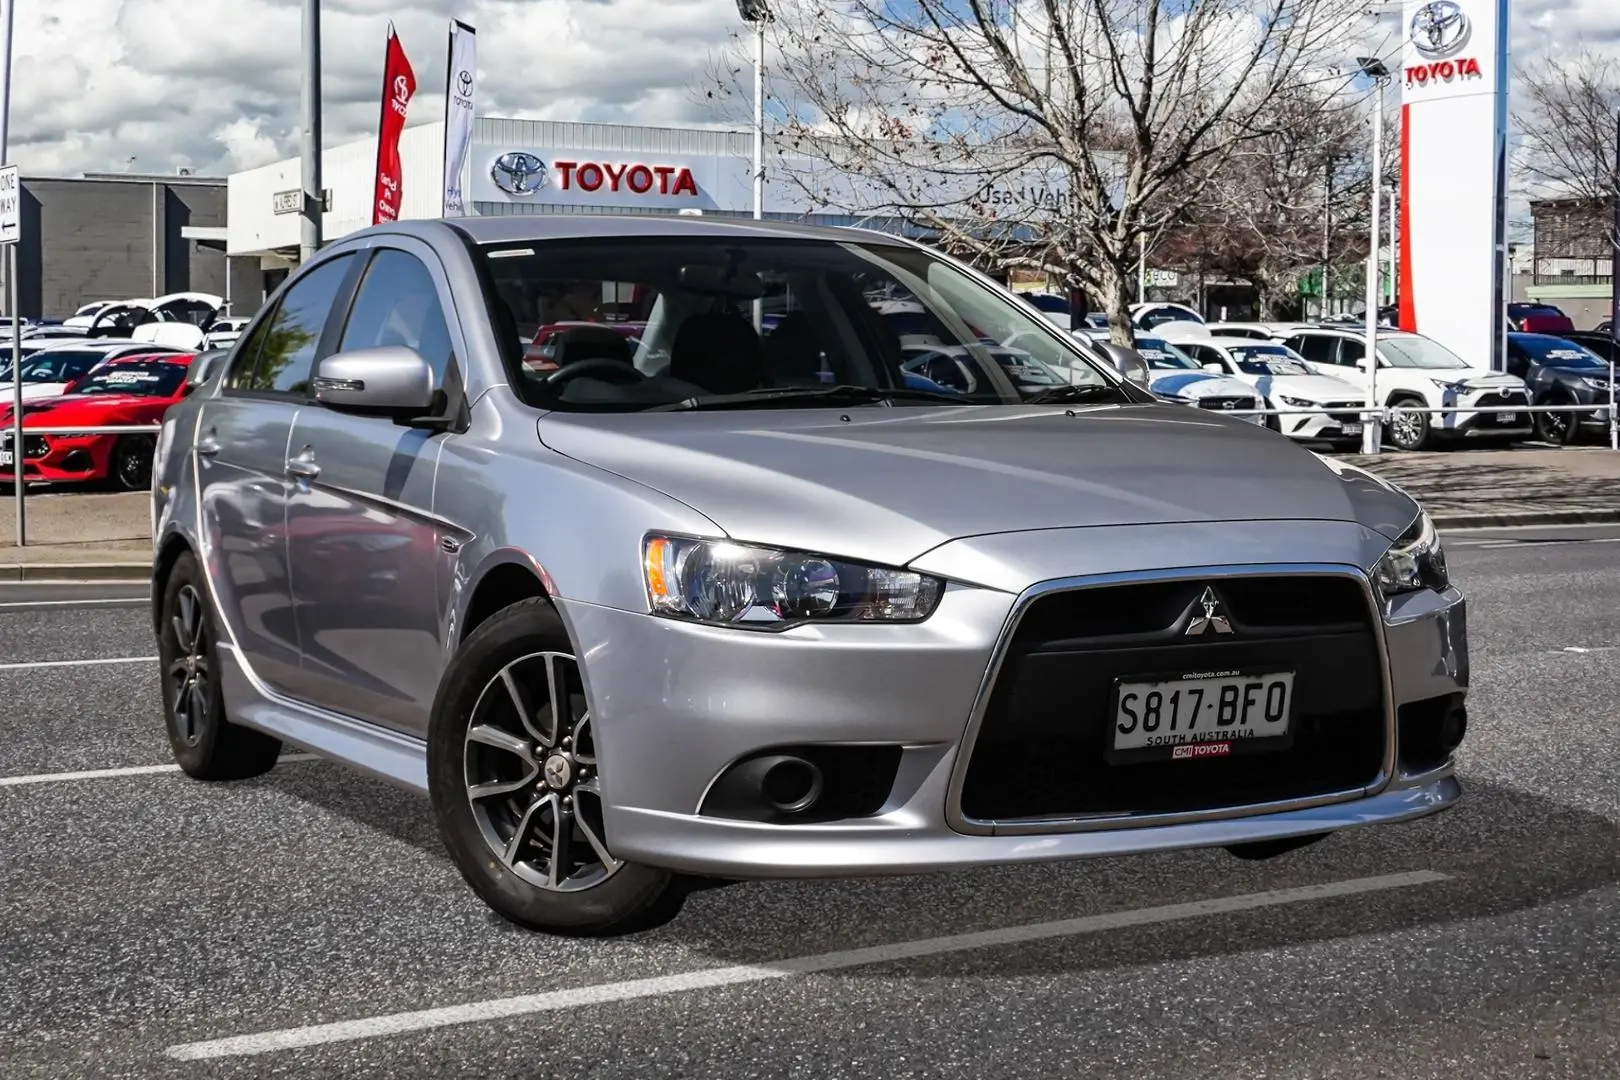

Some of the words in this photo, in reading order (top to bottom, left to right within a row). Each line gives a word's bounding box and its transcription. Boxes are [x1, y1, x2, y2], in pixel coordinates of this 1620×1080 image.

[1404, 58, 1481, 83] TOYOTA
[0, 173, 16, 191] ONE
[554, 161, 698, 196] TOYOTA
[0, 195, 16, 214] WAY
[1182, 670, 1240, 680] cmitoyota.com.au
[1146, 734, 1186, 746] SOUTH
[1191, 728, 1255, 743] AUSTRALIA
[1194, 743, 1230, 756] TOYOTA
